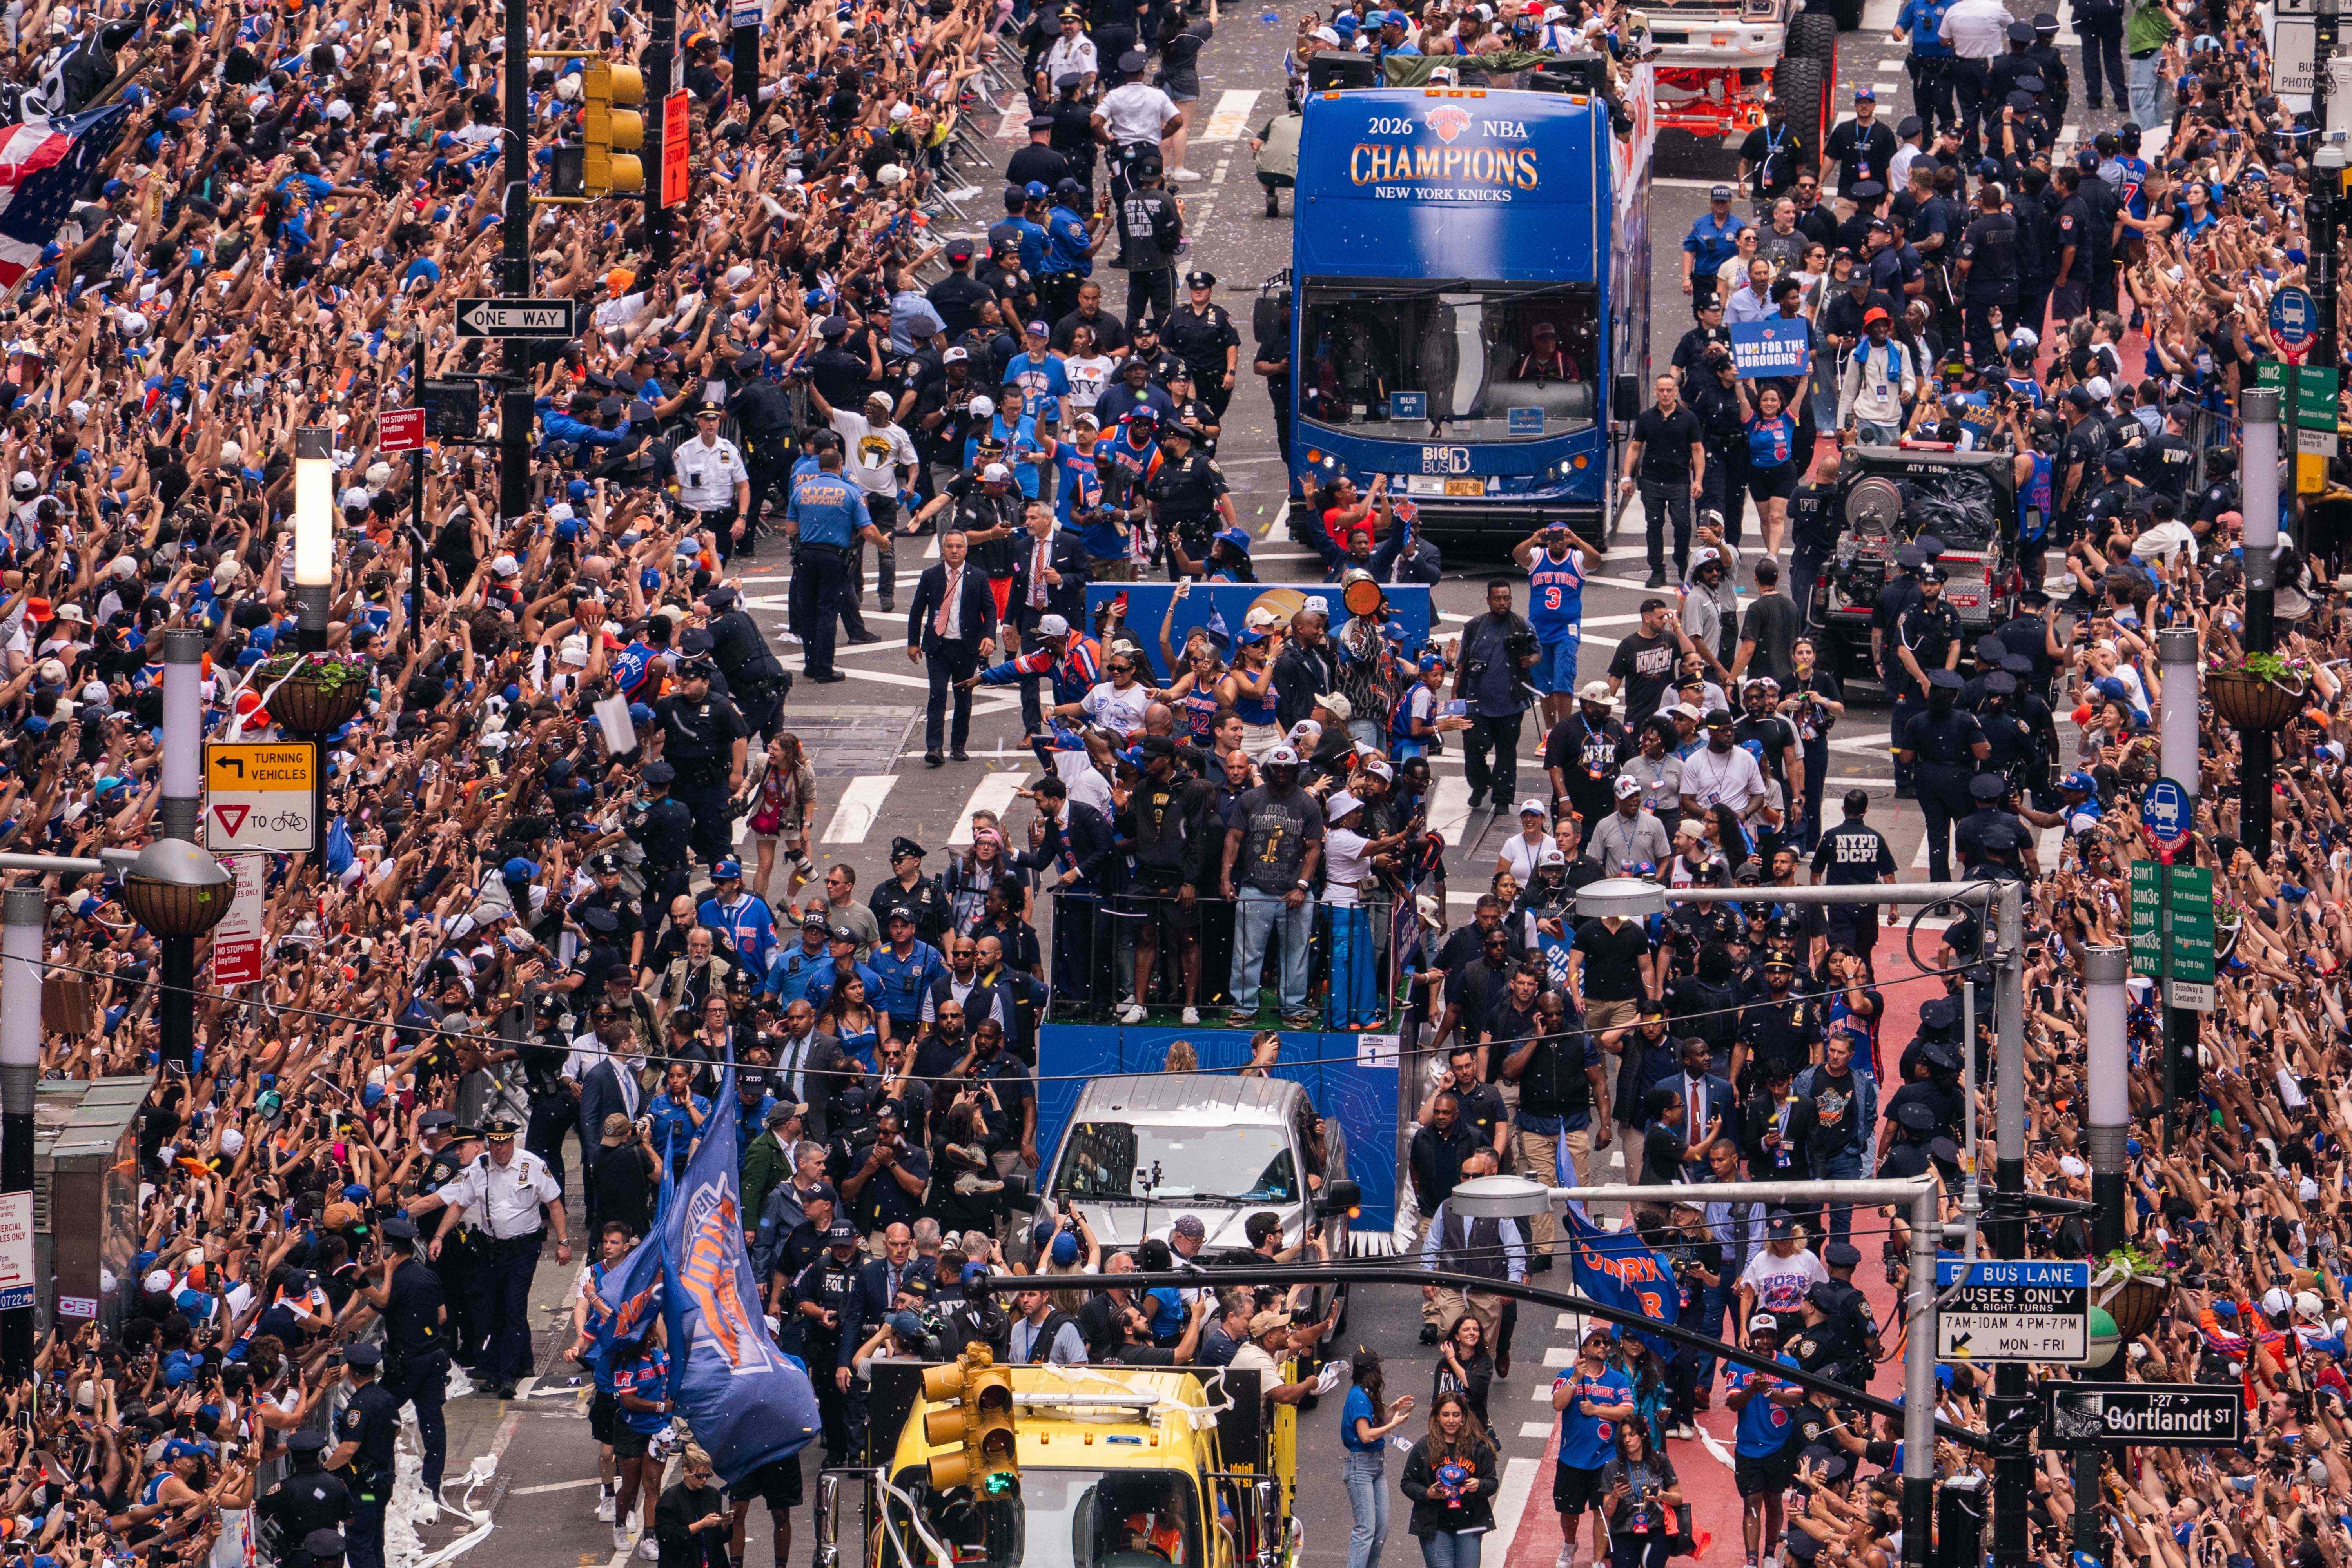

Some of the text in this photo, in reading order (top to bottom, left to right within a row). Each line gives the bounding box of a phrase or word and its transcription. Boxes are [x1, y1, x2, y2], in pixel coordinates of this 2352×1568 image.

[667, 120, 685, 139] STREET
[1368, 117, 1413, 135] 2026
[1483, 120, 1528, 138] NBA
[666, 147, 685, 167] DETOUR
[1350, 143, 1538, 190] CHAMPIONS
[1375, 187, 1512, 201] NEW YORK KNICKS
[1128, 224, 1153, 236] WORLD
[475, 310, 557, 325] ONE WAY
[1735, 339, 1805, 356] WON FOR THE
[2274, 332, 2314, 352] NO STANDING
[1737, 354, 1796, 367] BOROUGHS
[1073, 367, 1081, 378] I
[2259, 365, 2280, 380] SIM2
[2301, 368, 2324, 378] Tottenville
[1071, 380, 1099, 394] NY
[2300, 388, 2314, 397] Travis
[382, 413, 417, 424] NO STOPPING
[382, 424, 405, 434] Anytime
[2299, 431, 2322, 441] Broadway
[2299, 439, 2316, 448] Liberty
[1423, 446, 1449, 460] BIG
[1423, 461, 1449, 473] BUS
[1906, 464, 1924, 472] ATV
[801, 487, 846, 496] NYPD
[1532, 572, 1579, 590] NEW YORK
[1545, 586, 1562, 610] 3
[1262, 696, 1276, 709] 32
[1188, 711, 1210, 735] 32
[254, 753, 303, 765] TURNING
[251, 769, 306, 780] VEHICLES
[251, 815, 267, 828] TO
[1835, 834, 1878, 849] NYPD
[2146, 830, 2187, 851] NO STANDING
[1836, 849, 1878, 862] DCPI
[2134, 866, 2153, 882] SIM1
[2174, 869, 2198, 879] Eltingville
[245, 889, 259, 897] ONLY
[2133, 888, 2159, 905] SIM3c
[2174, 891, 2207, 902] Port Richmond
[806, 914, 824, 923] NYPD
[2133, 911, 2154, 926] SIM4
[2174, 913, 2197, 923] Annadale
[734, 926, 757, 938] YORK
[2175, 936, 2212, 947] Mariners Harbor
[217, 943, 254, 955] NO STOPPING
[217, 956, 241, 966] Anytime
[2133, 955, 2156, 971] MTA
[2175, 958, 2186, 969] Drop
[2195, 960, 2205, 971] Only
[2175, 984, 2198, 995] Broadway
[2174, 993, 2203, 1004] Cortlandt St
[1368, 1047, 1376, 1063] 1
[0, 1222, 22, 1232] ERCIAL
[830, 1227, 849, 1236] NYPD
[12, 1232, 25, 1240] ONLY
[2, 1262, 18, 1271] Sunday
[1984, 1267, 2073, 1283] BUS LANE
[1763, 1275, 1806, 1292] 2026
[1949, 1288, 2076, 1304] USES ONLY
[2000, 1339, 2065, 1351] MON FRI
[2149, 1394, 2172, 1407] 1-27
[2107, 1406, 2231, 1431] Cortlandt ST
